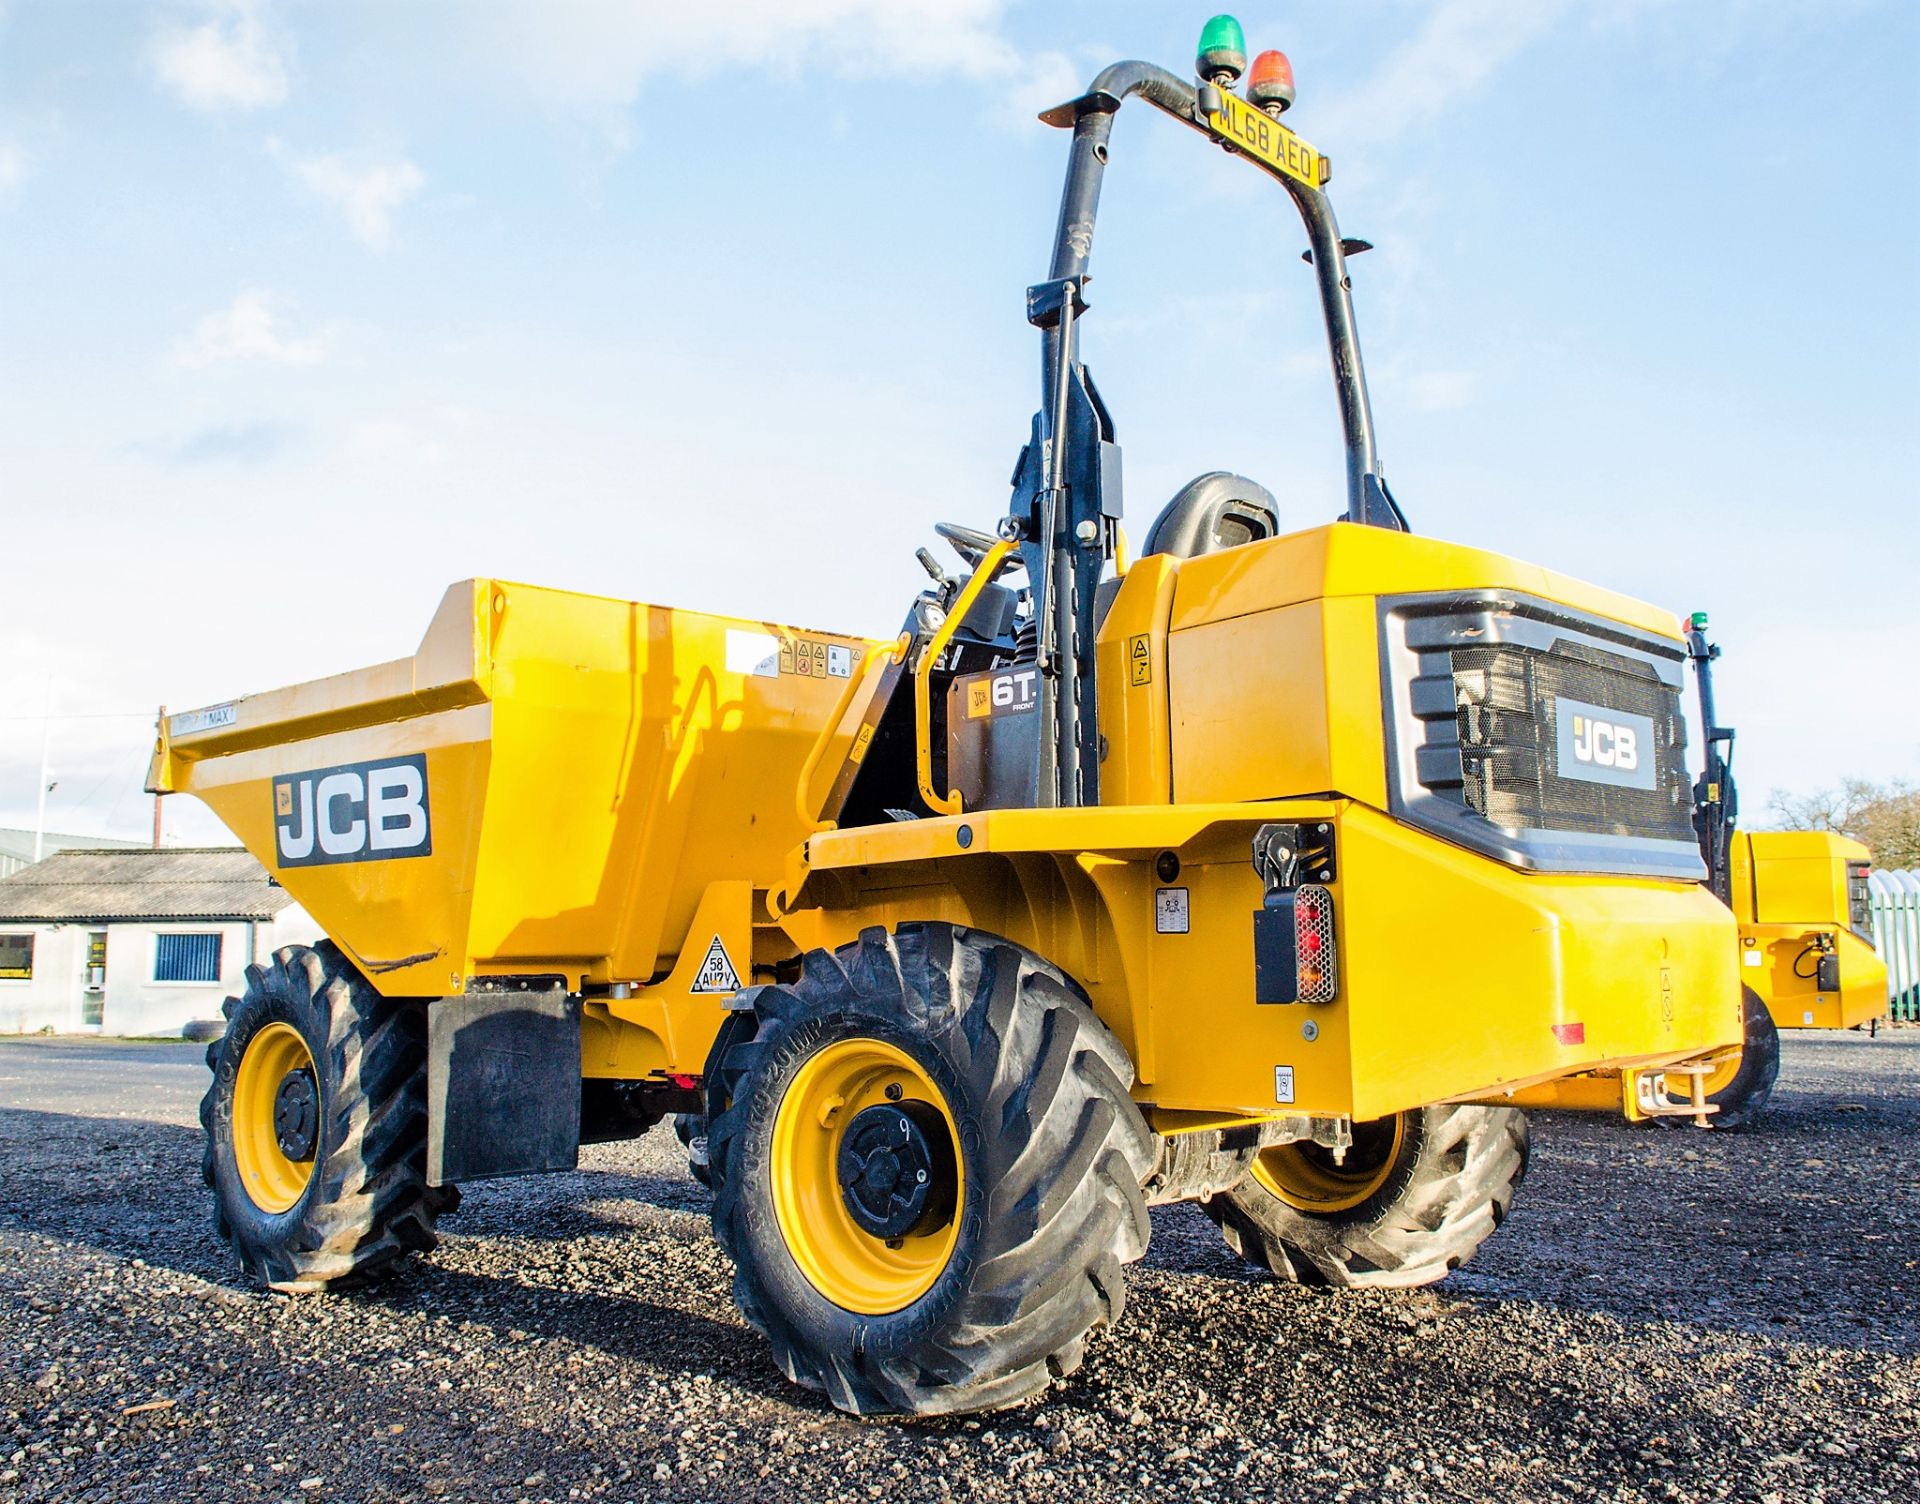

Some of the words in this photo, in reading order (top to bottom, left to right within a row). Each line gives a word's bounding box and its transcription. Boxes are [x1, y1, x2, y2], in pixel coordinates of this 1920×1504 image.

[1219, 98, 1269, 154] ML68
[209, 709, 229, 725] MAX
[1012, 701, 1035, 711] FRONT
[1574, 718, 1637, 770] JCB
[278, 764, 427, 859] JCB
[710, 957, 723, 971] 58
